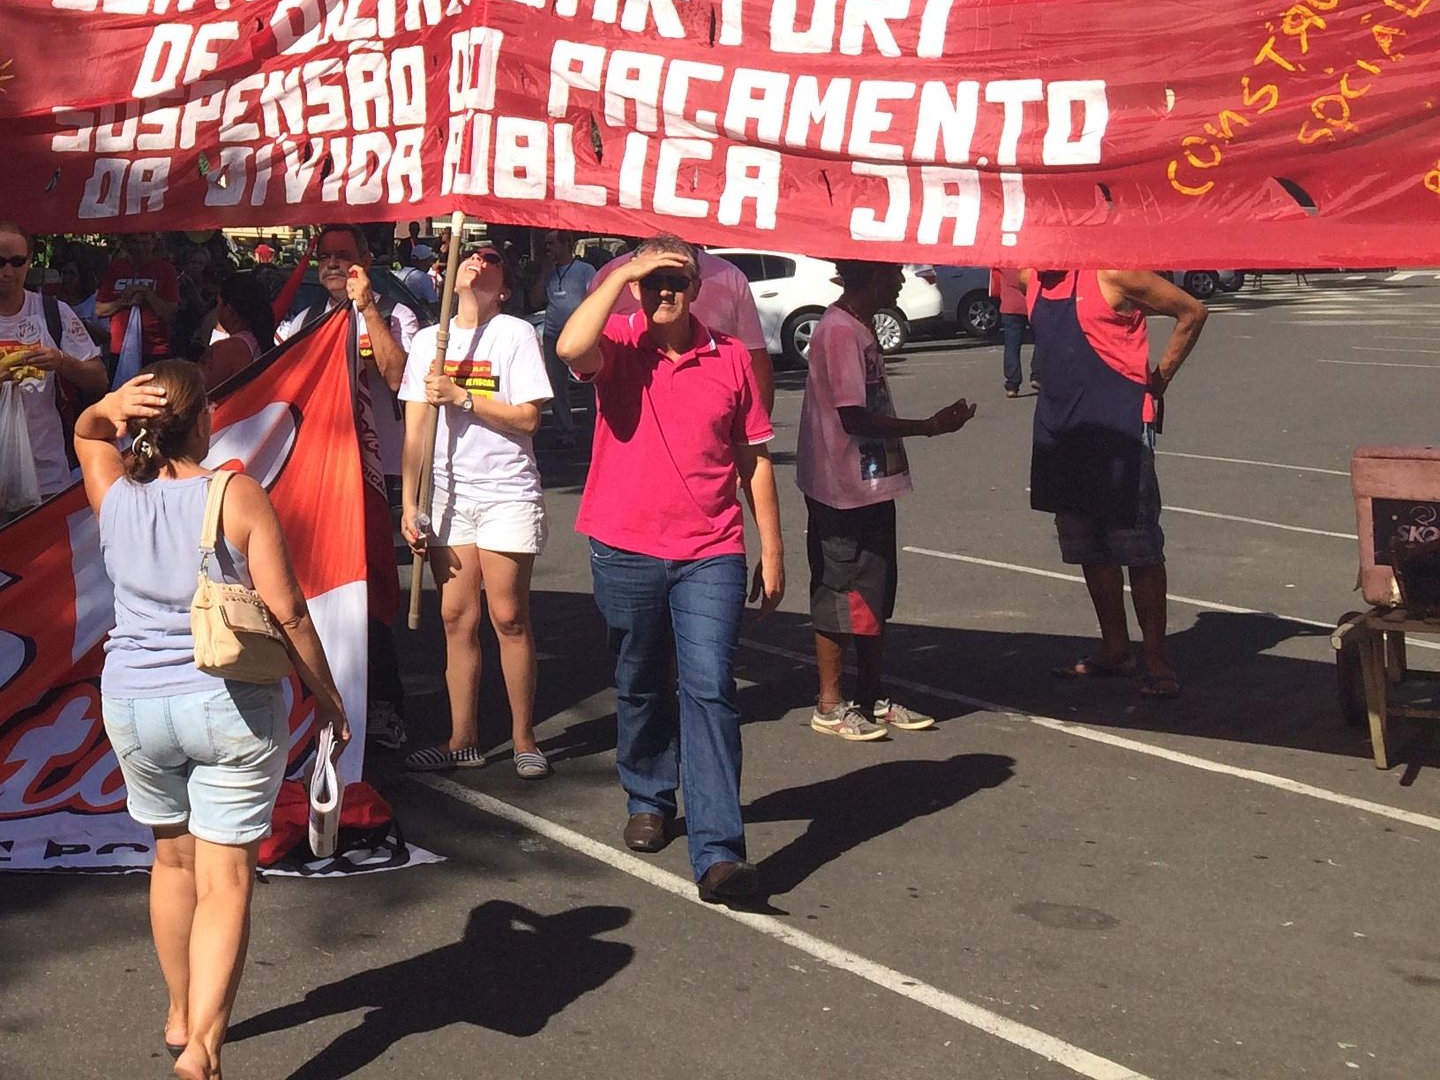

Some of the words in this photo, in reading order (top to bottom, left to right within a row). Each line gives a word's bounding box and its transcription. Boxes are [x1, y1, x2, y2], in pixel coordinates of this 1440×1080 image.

[51, 39, 427, 153] SUSPENSÃO
[449, 26, 504, 112] DO
[547, 39, 1108, 166] PAGAMENTO
[132, 21, 239, 99] DE
[78, 157, 172, 219] DA
[204, 128, 425, 208] DÍVIDA
[850, 156, 1025, 245] JÁ!
